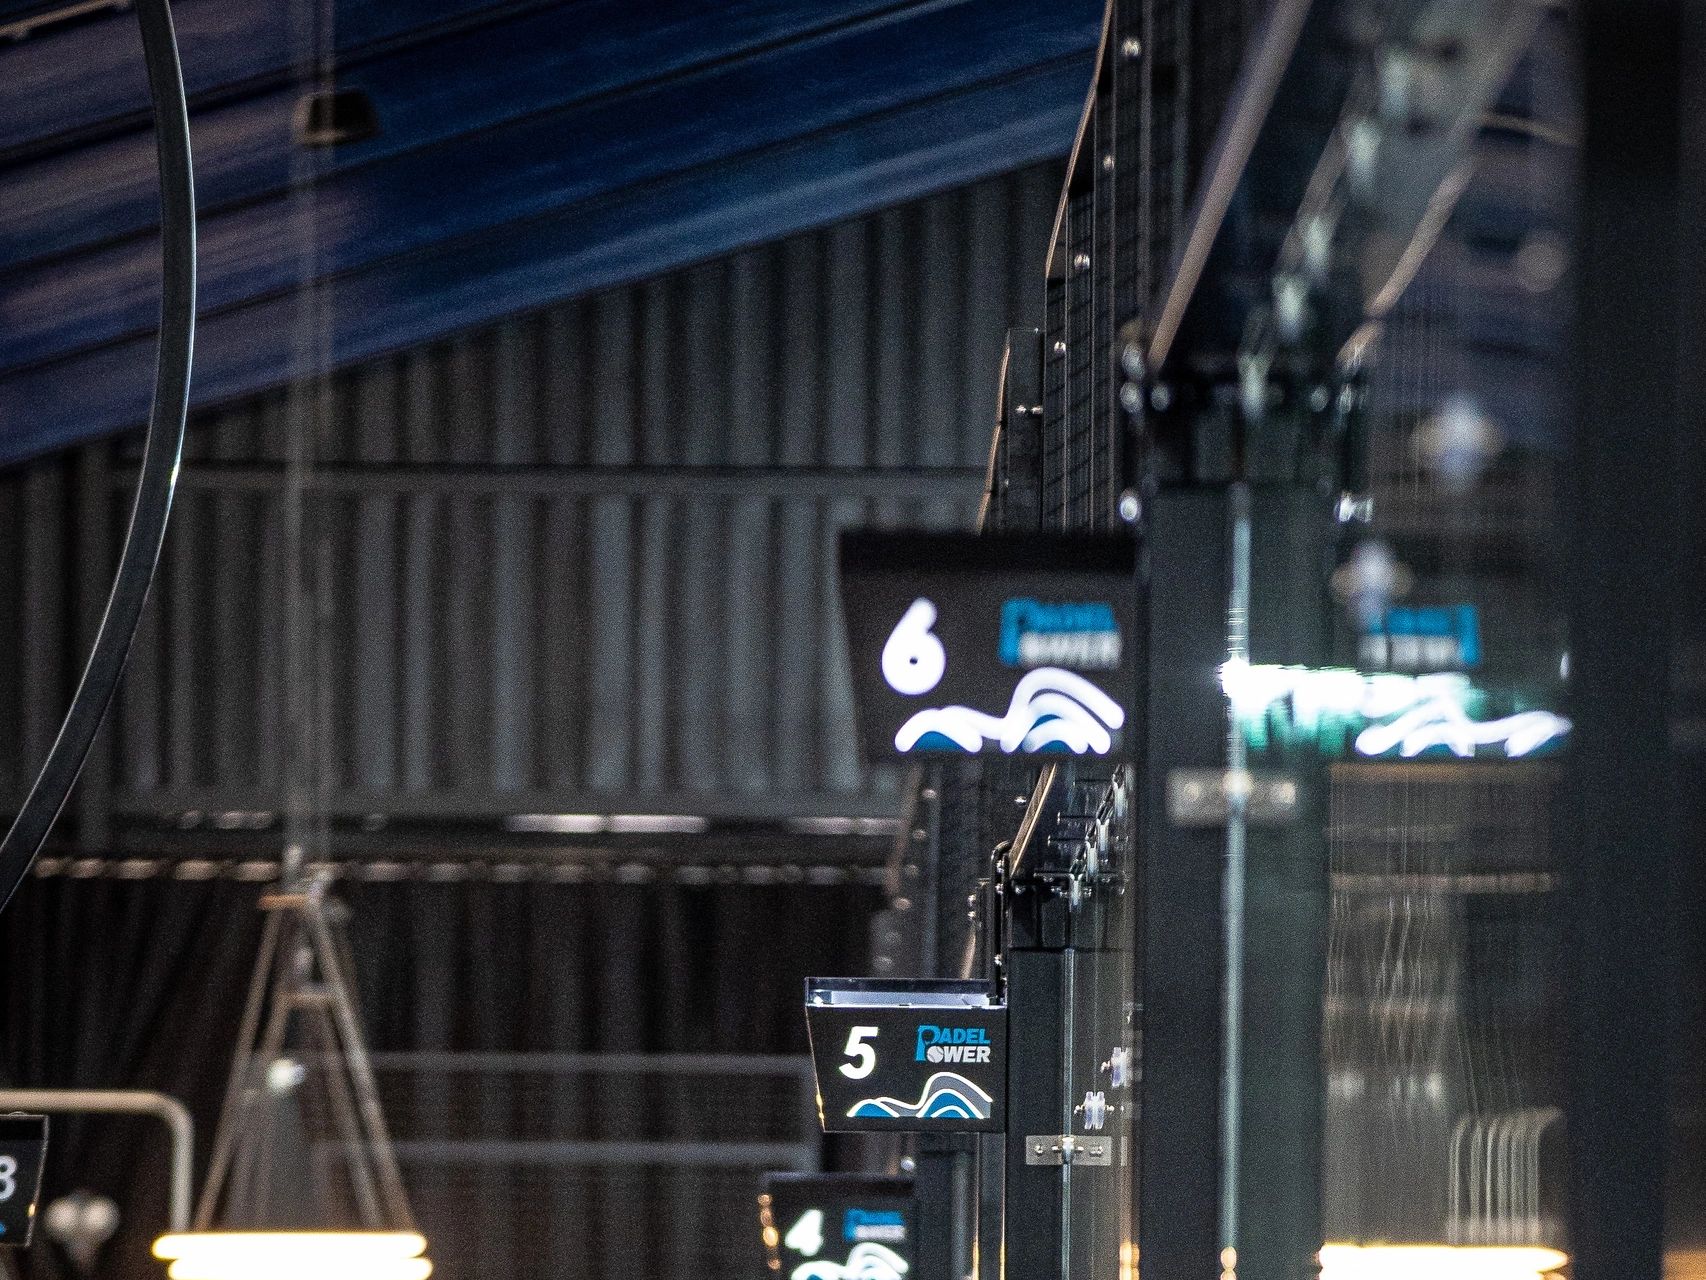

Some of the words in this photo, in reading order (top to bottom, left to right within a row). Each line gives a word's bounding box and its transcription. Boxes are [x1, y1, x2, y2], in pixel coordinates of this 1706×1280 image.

[881, 597, 946, 696] 6
[839, 1026, 879, 1080] 5
[915, 1024, 991, 1063] PADEL
[784, 1208, 824, 1257] 4
